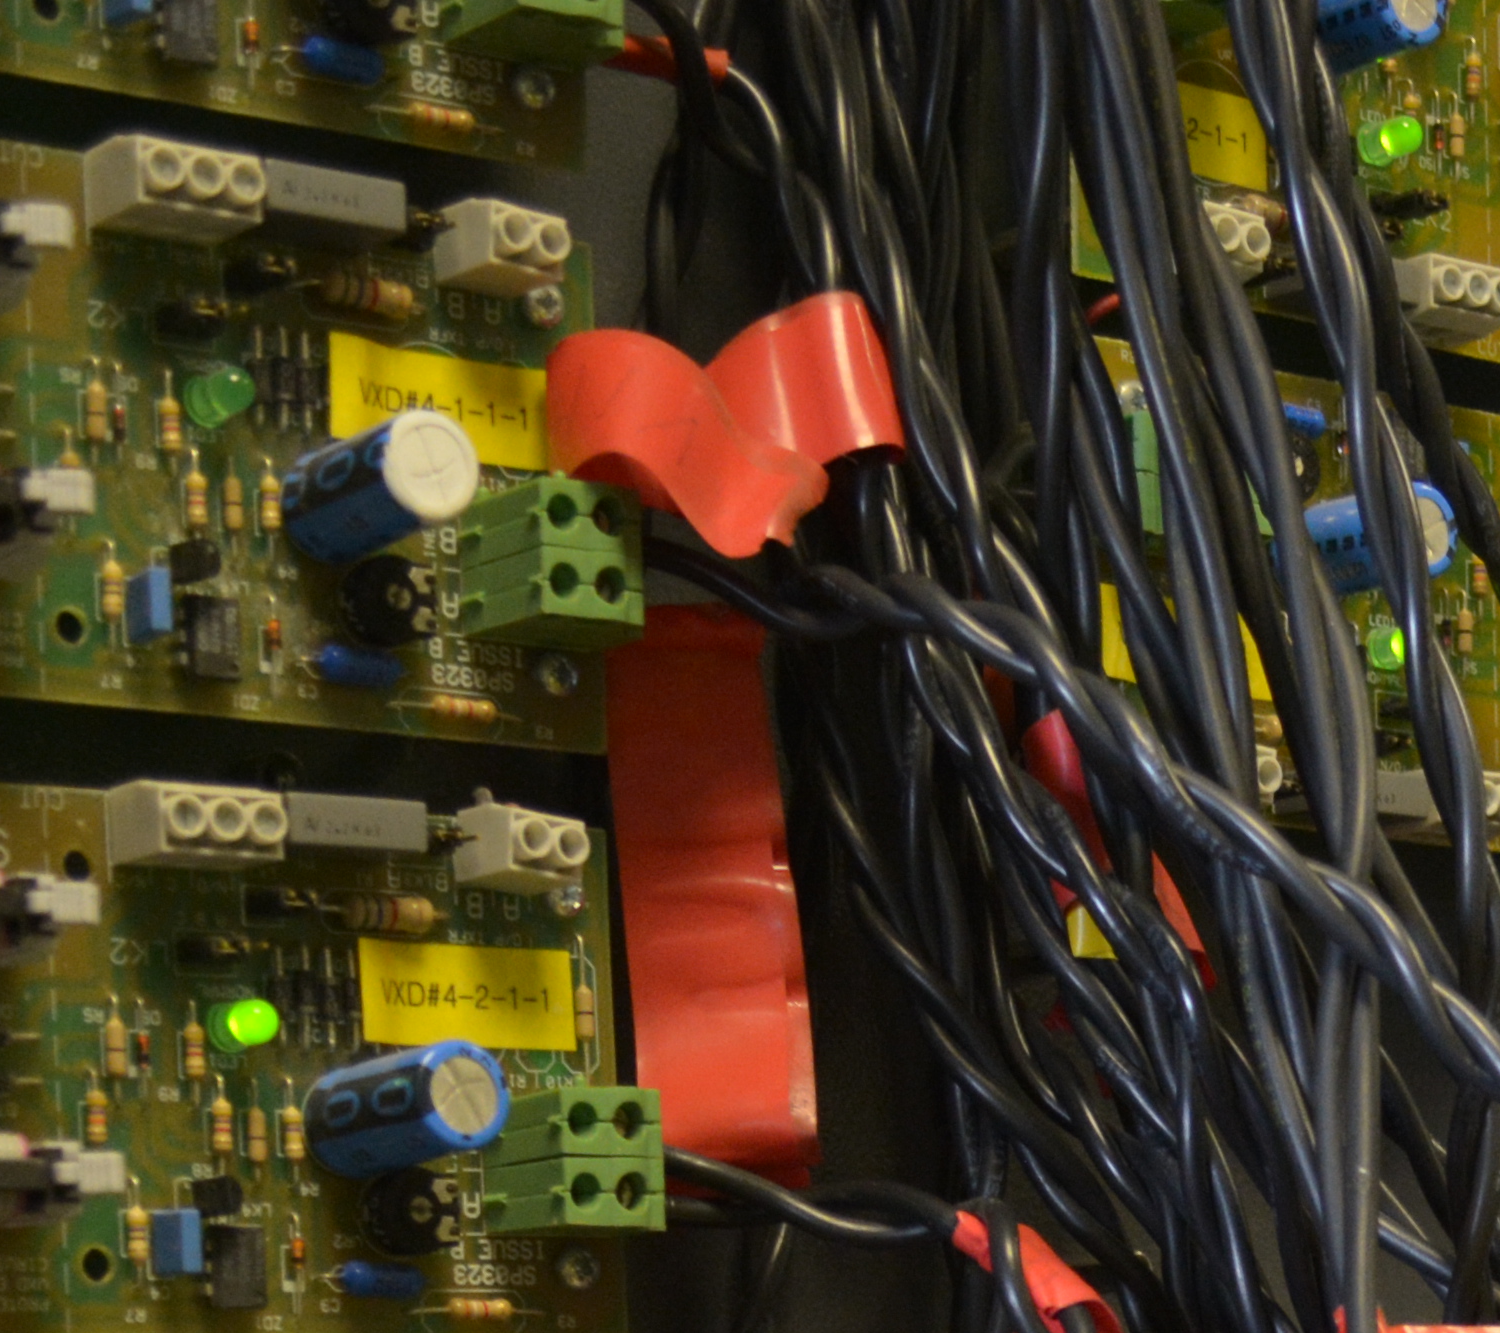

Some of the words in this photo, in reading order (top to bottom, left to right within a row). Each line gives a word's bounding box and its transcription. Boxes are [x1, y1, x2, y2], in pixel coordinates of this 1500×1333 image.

[446, 293, 465, 319] B
[484, 299, 501, 323] A
[440, 529, 457, 555] B
[441, 593, 458, 617] A
[456, 642, 523, 668] ISSUE
[431, 663, 515, 690] SP0323
[466, 892, 485, 919] B
[503, 895, 521, 920] A
[380, 980, 550, 1009] VXD#4-2-1-1
[460, 1191, 481, 1215] A
[477, 1238, 544, 1262] ISSUE
[453, 1262, 537, 1285] SP0323
